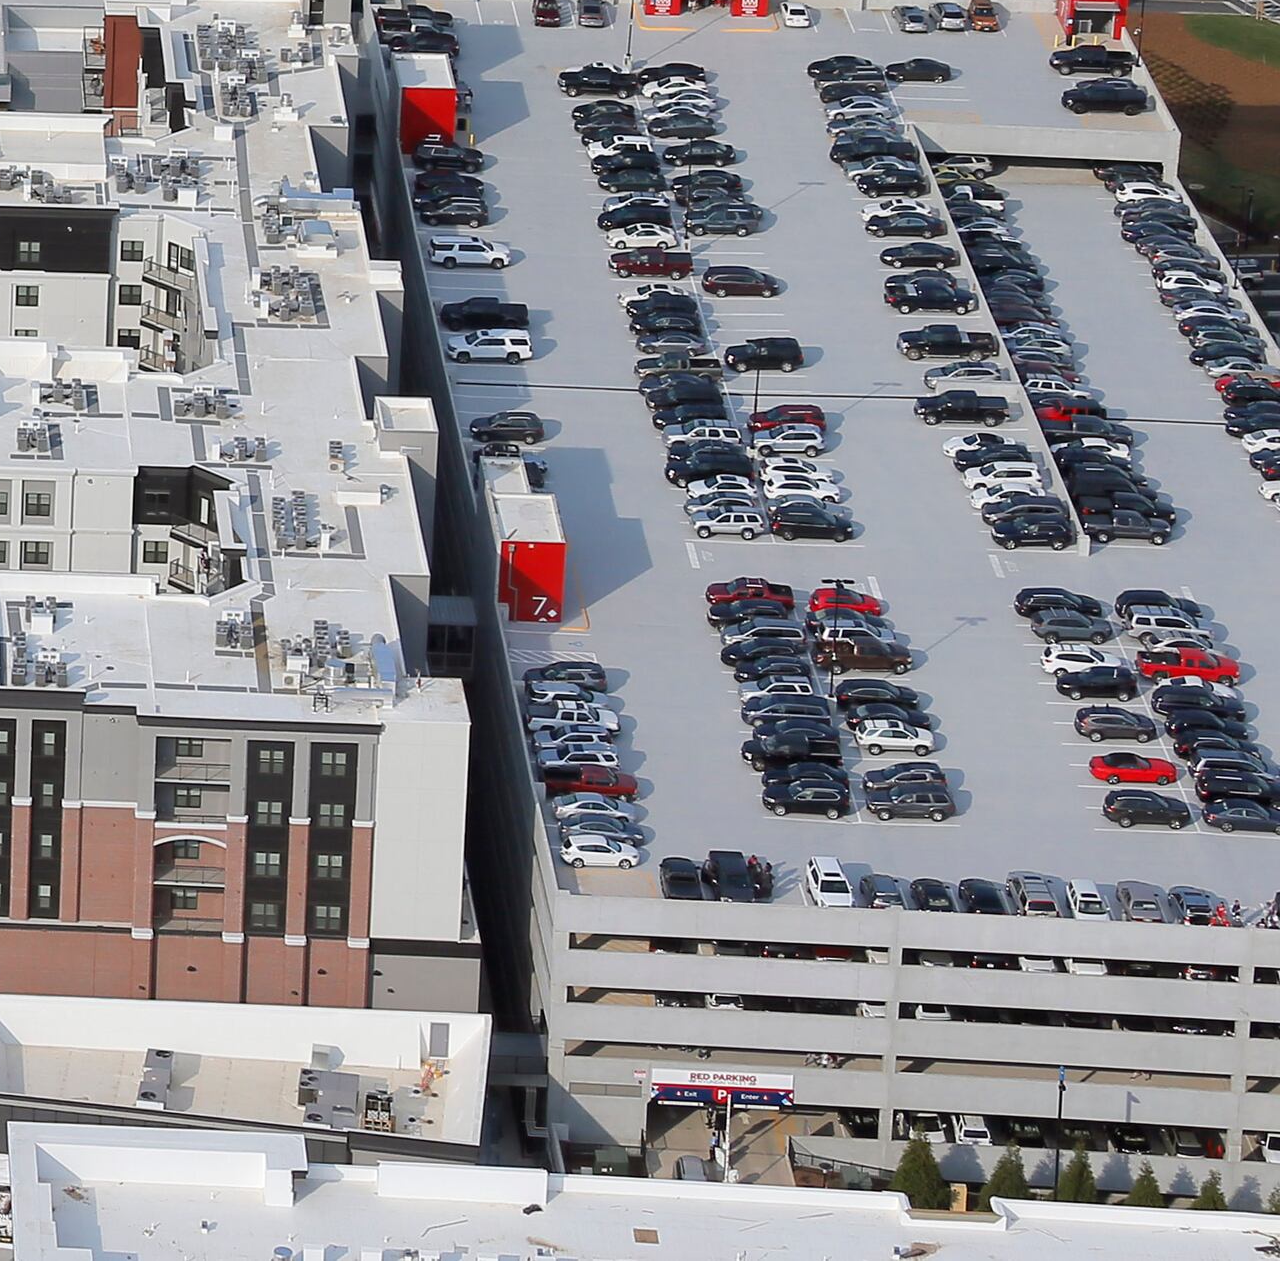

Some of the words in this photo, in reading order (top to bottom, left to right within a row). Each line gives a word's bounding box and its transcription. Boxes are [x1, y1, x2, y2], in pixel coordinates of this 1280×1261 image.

[532, 596, 548, 616] 7
[690, 1072, 711, 1081] RED
[713, 1073, 757, 1082] PARKING
[717, 1089, 728, 1100] P
[741, 1093, 760, 1101] Enter
